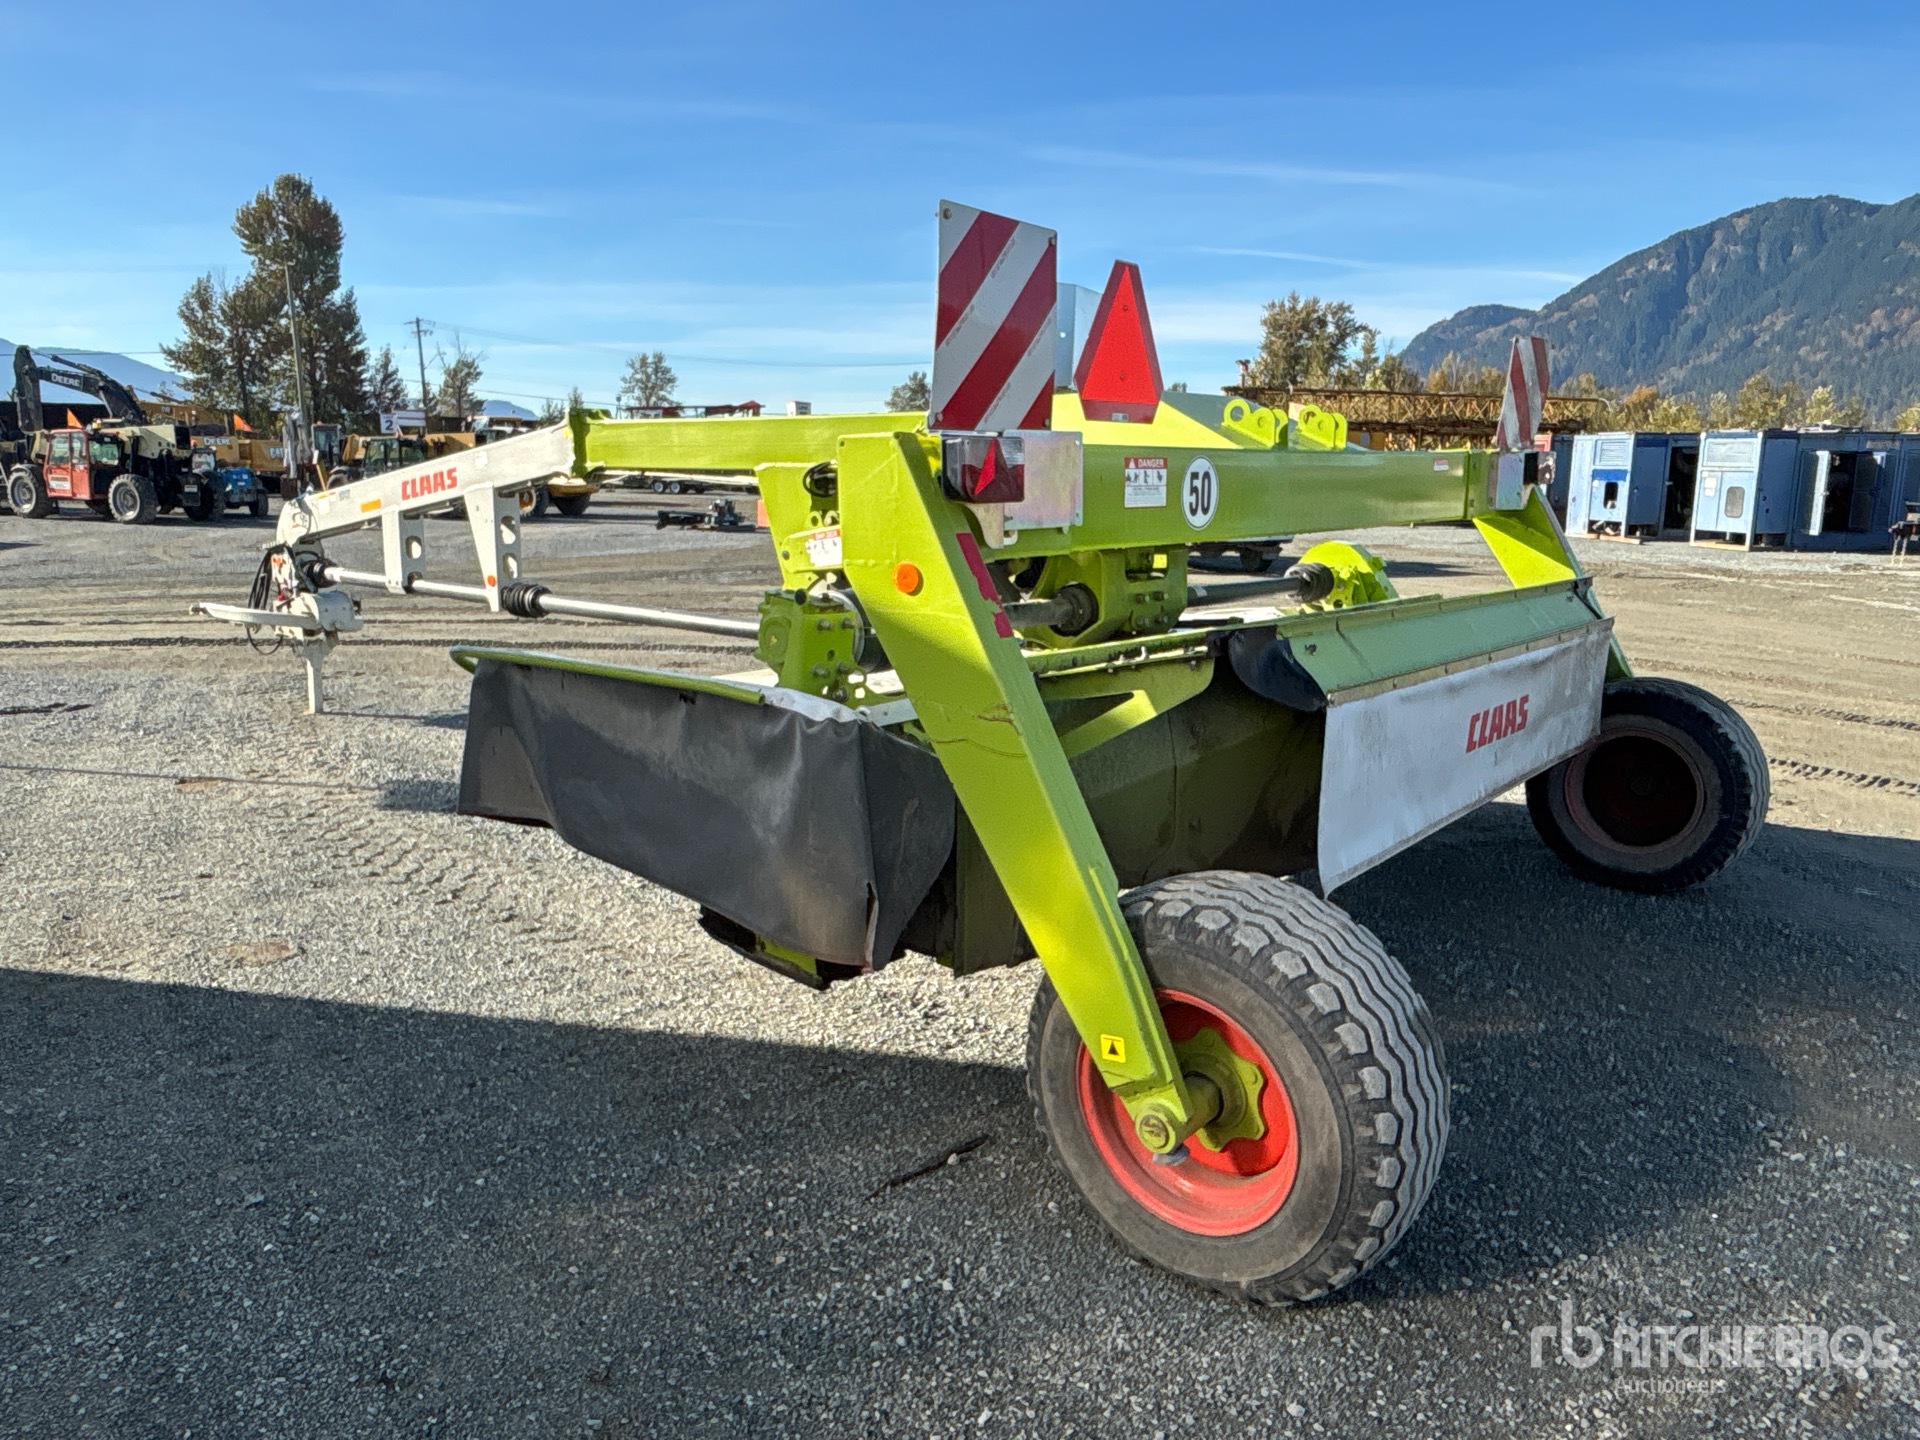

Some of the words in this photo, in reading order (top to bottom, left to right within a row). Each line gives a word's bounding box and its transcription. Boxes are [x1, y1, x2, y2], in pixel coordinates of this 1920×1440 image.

[51, 373, 81, 387] DEERE
[385, 420, 394, 431] 2
[1137, 458, 1164, 468] DANGER
[401, 467, 458, 501] CLAAS
[1189, 470, 1212, 517] 50
[1466, 694, 1529, 753] CLAAS
